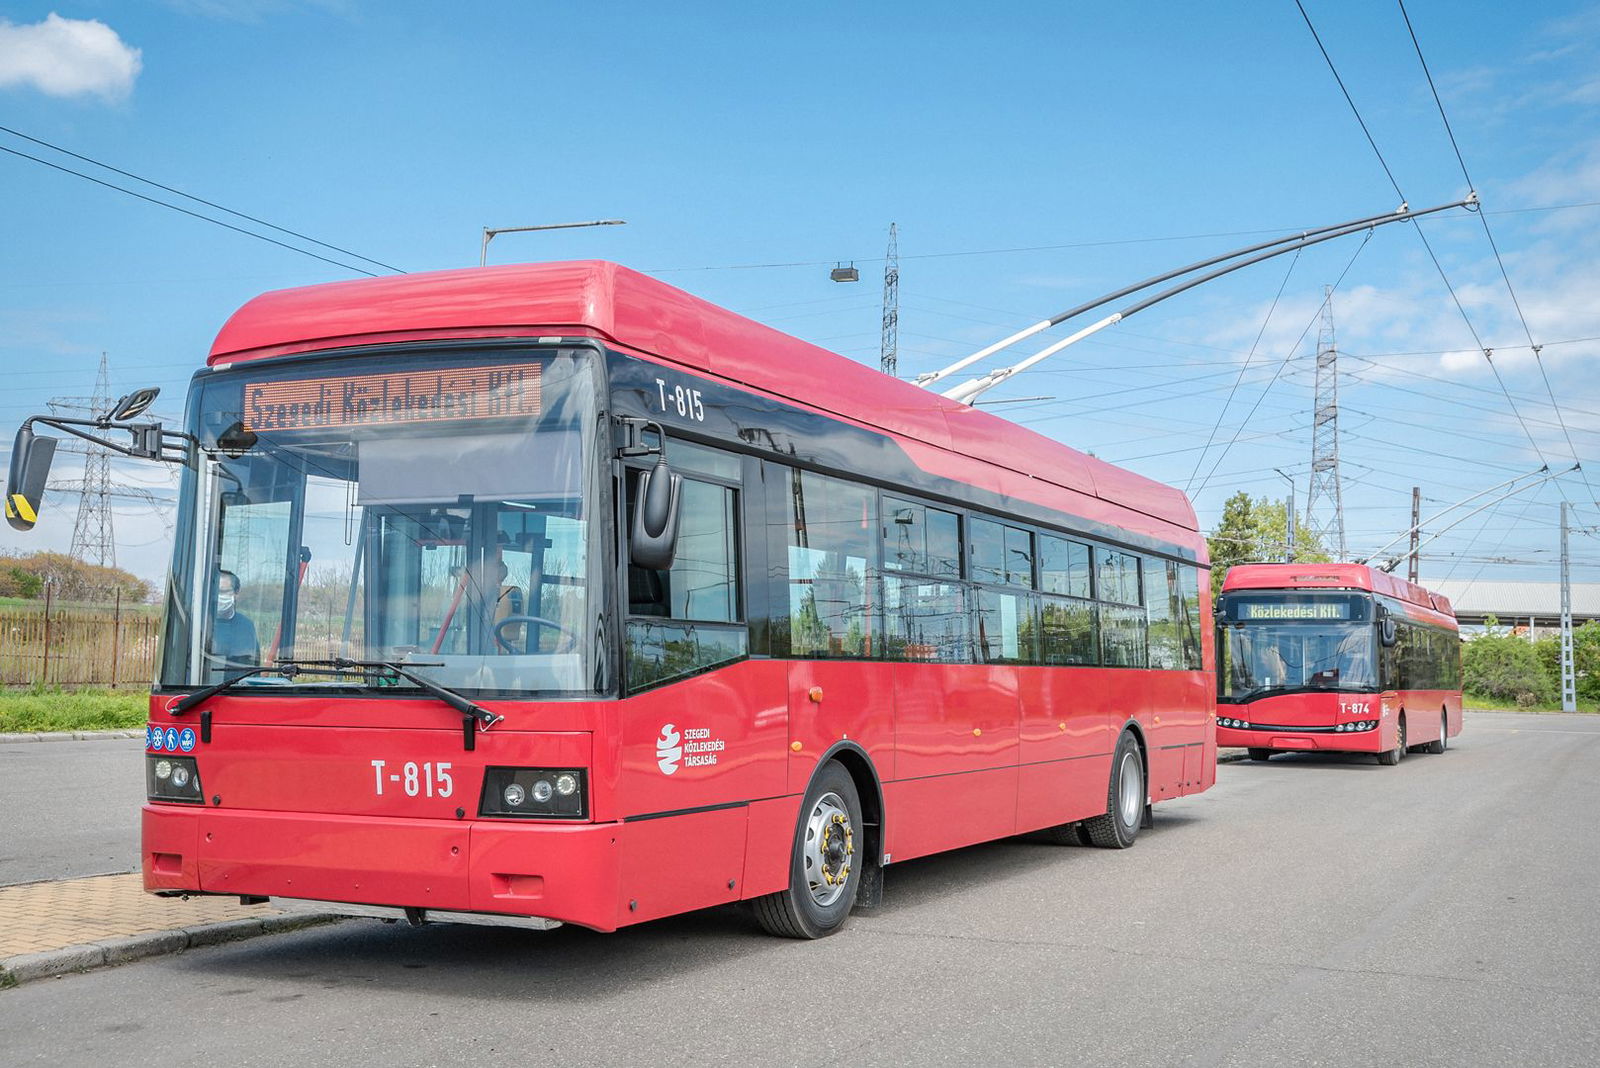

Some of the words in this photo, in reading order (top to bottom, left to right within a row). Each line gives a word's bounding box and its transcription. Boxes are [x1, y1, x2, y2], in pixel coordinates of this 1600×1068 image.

[251, 384, 331, 427] Szegedi
[344, 377, 477, 425] Közlekedési
[656, 378, 704, 422] T-815
[1251, 603, 1317, 618] Közlekedési
[1320, 603, 1340, 618] Kft.
[1340, 703, 1370, 714] T-874
[684, 728, 710, 740] SZEGEDI
[684, 739, 725, 754] KÖZLEKEDÉSI
[684, 753, 717, 767] TÁRSASÁG
[371, 760, 453, 798] T-815
